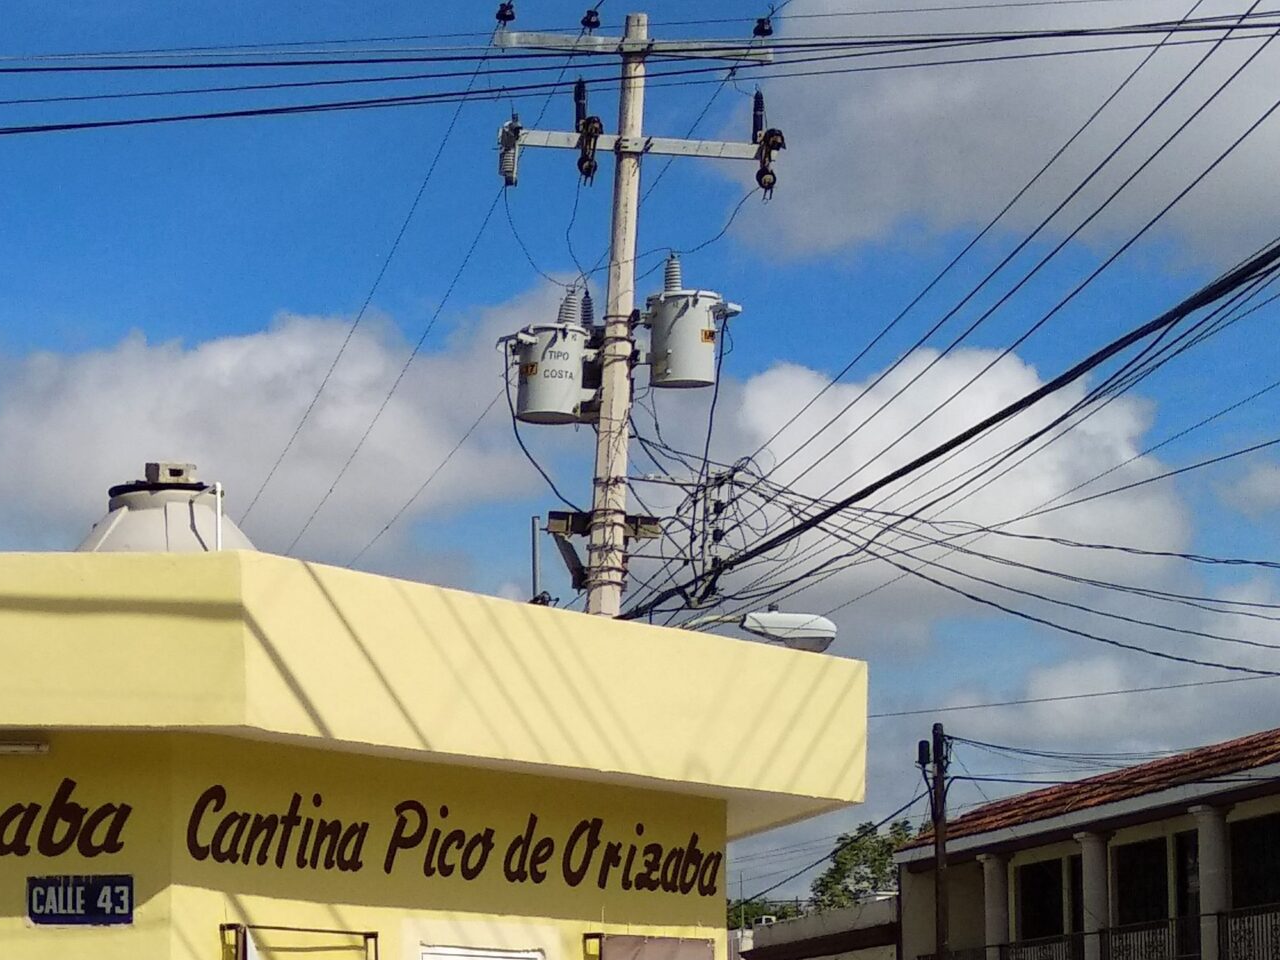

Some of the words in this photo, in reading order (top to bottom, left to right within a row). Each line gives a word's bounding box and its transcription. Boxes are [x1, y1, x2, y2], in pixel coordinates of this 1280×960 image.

[549, 350, 570, 361] TIPO
[543, 369, 575, 380] COSTA
[186, 784, 369, 872] Cantina
[384, 800, 495, 880] Pico
[504, 813, 555, 884] de
[562, 817, 722, 896] Orizaba
[32, 886, 85, 914] CALLE
[96, 885, 129, 914] 43
